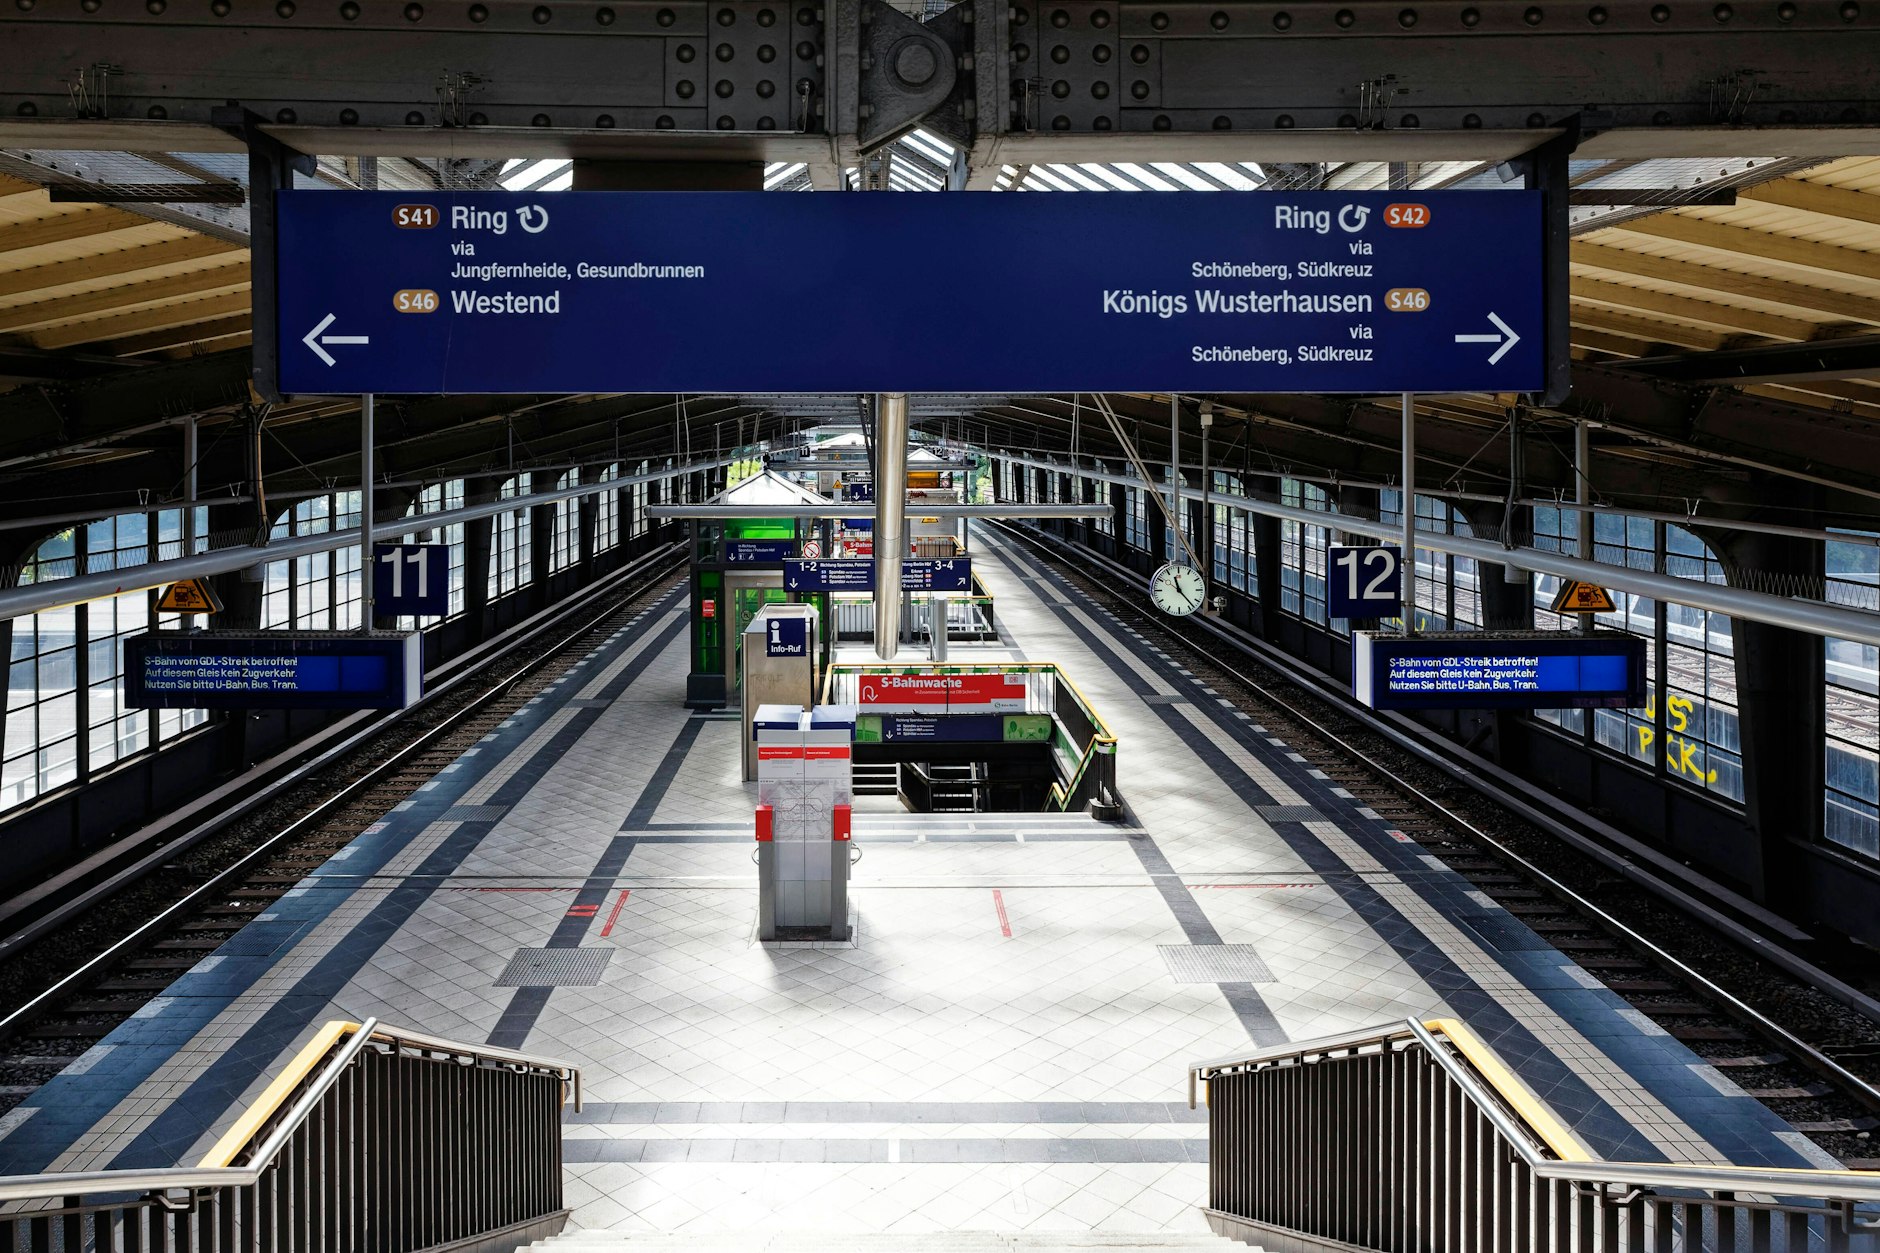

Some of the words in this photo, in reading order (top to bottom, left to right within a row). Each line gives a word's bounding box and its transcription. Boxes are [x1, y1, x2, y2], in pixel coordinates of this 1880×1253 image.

[399, 207, 432, 226] S41
[451, 206, 508, 234] Ring
[1275, 206, 1330, 234] Ring
[1389, 207, 1425, 225] S42
[451, 241, 475, 256] via
[1349, 240, 1373, 255] via
[451, 262, 571, 281] Jungfernheide,
[576, 262, 705, 278] Gesundbrunnen
[1191, 261, 1293, 280] Schöneberg,
[1298, 261, 1373, 278] Südkreuz
[399, 292, 435, 311] S46
[451, 291, 560, 314] Westend
[1103, 290, 1188, 318] Königs
[1194, 290, 1372, 313] Wusterhausen
[1390, 292, 1427, 309] S46
[1349, 324, 1373, 339] via
[1191, 346, 1293, 365] Schöneberg,
[1298, 346, 1373, 361] Südkreuz
[381, 547, 429, 598] 11
[800, 562, 817, 572] 1-2
[935, 560, 954, 570] 3-4
[1336, 549, 1395, 600] 12
[145, 656, 177, 666] S-Bahn
[200, 656, 250, 666] GDL-Streik
[251, 656, 298, 666] betroffen!
[1390, 658, 1420, 667] S-Bahn
[1422, 659, 1441, 667] vom
[1443, 657, 1492, 666] GDL-Streik
[1493, 657, 1538, 666] betroffen!
[145, 668, 161, 677] Auf
[163, 668, 195, 677] diesem
[197, 668, 220, 677] Gleis
[221, 668, 240, 677] kein
[242, 668, 297, 679] Zugverkehr.
[1390, 670, 1405, 678] Auf
[1407, 670, 1439, 678] diesem
[1440, 670, 1462, 678] Gleis
[1464, 670, 1482, 678] kein
[1484, 669, 1538, 680] Zugverkehr.
[145, 680, 176, 689] Nutzen
[178, 680, 191, 689] Sie
[193, 680, 214, 689] bitte
[272, 680, 298, 689] Tram.
[881, 677, 962, 688] S-Bahnwache
[1390, 681, 1420, 690] Nutzen
[1421, 681, 1434, 689] Sie
[1436, 681, 1457, 689] bitte
[1458, 681, 1492, 690] U-Bahn,
[1493, 681, 1511, 690] Bus,
[1513, 681, 1538, 689] Tram.
